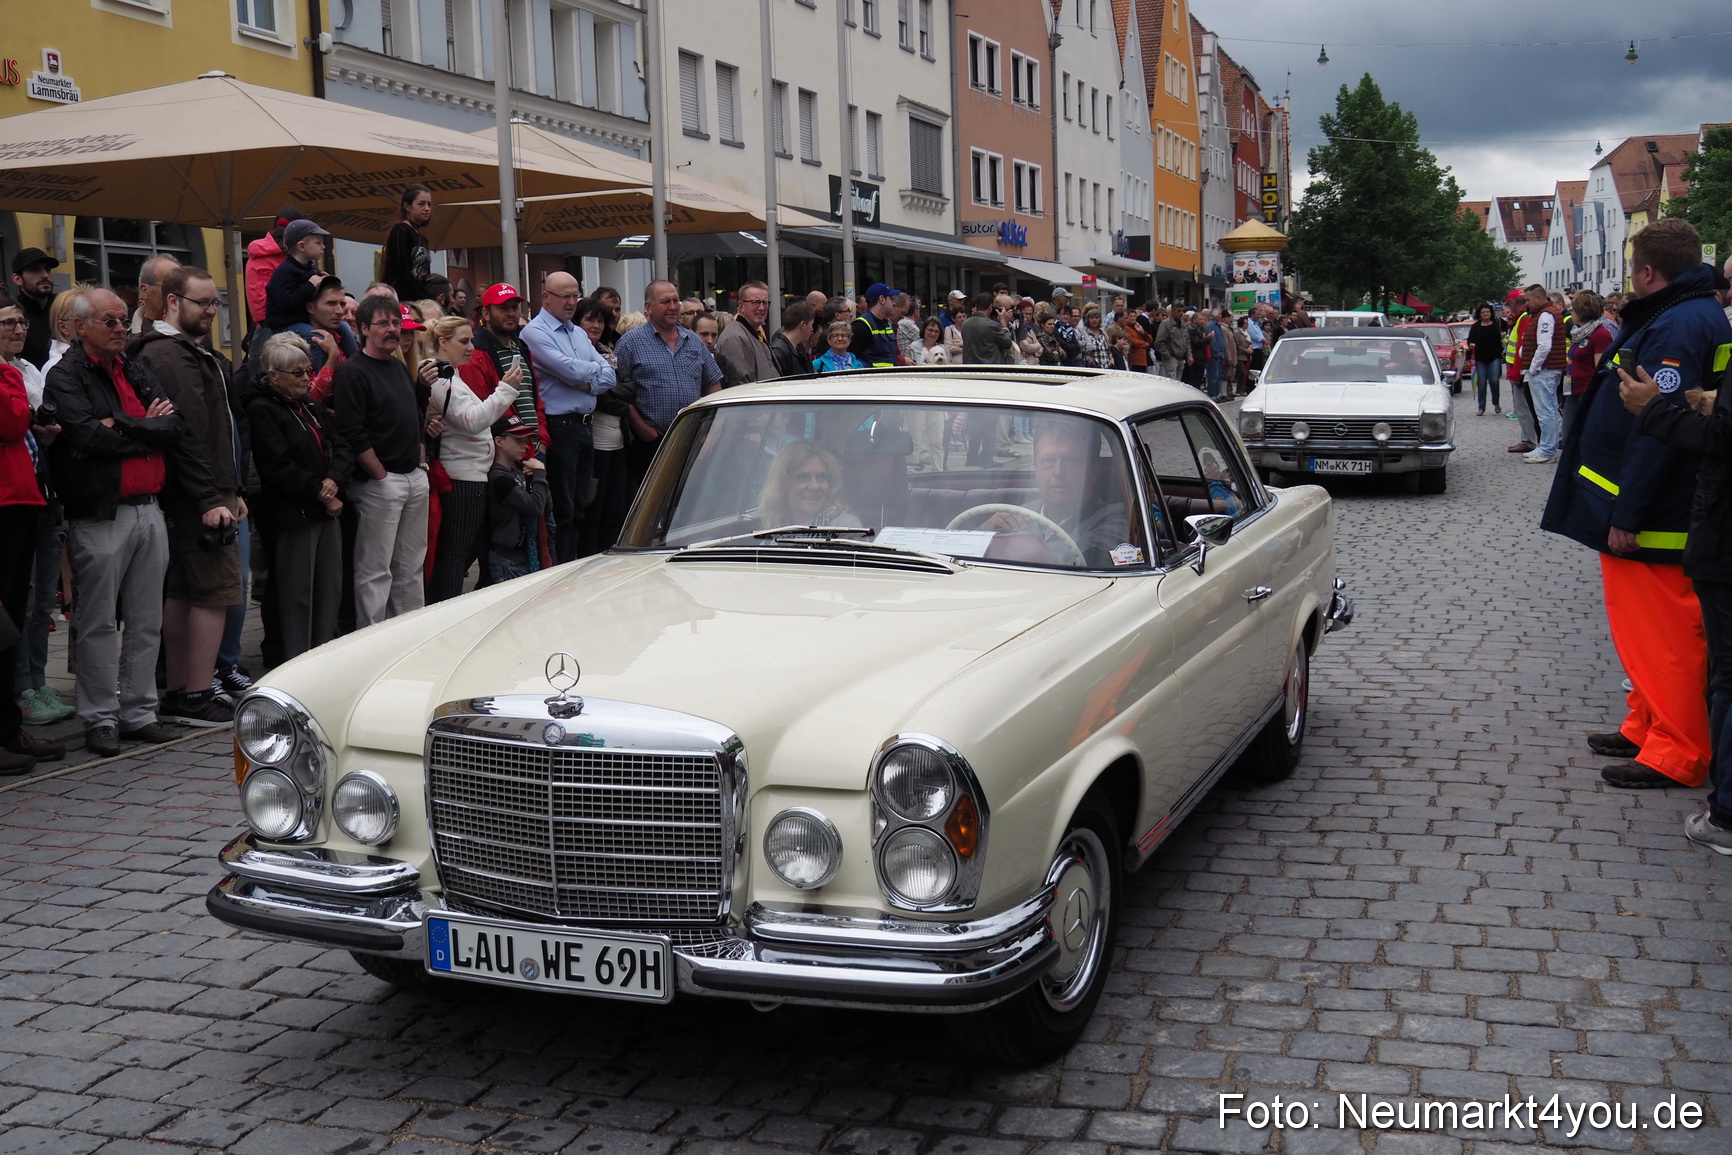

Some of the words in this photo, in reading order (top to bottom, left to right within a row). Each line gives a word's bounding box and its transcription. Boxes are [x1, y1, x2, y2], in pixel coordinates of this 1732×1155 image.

[37, 75, 72, 89] Neumarkter
[31, 83, 79, 102] Lammsbräu
[1315, 460, 1329, 470] NM
[1335, 461, 1349, 470] KK
[1351, 461, 1371, 471] 71H
[436, 949, 446, 962] D
[451, 928, 515, 975] LAU
[541, 939, 586, 983] WE
[595, 945, 661, 991] 69H
